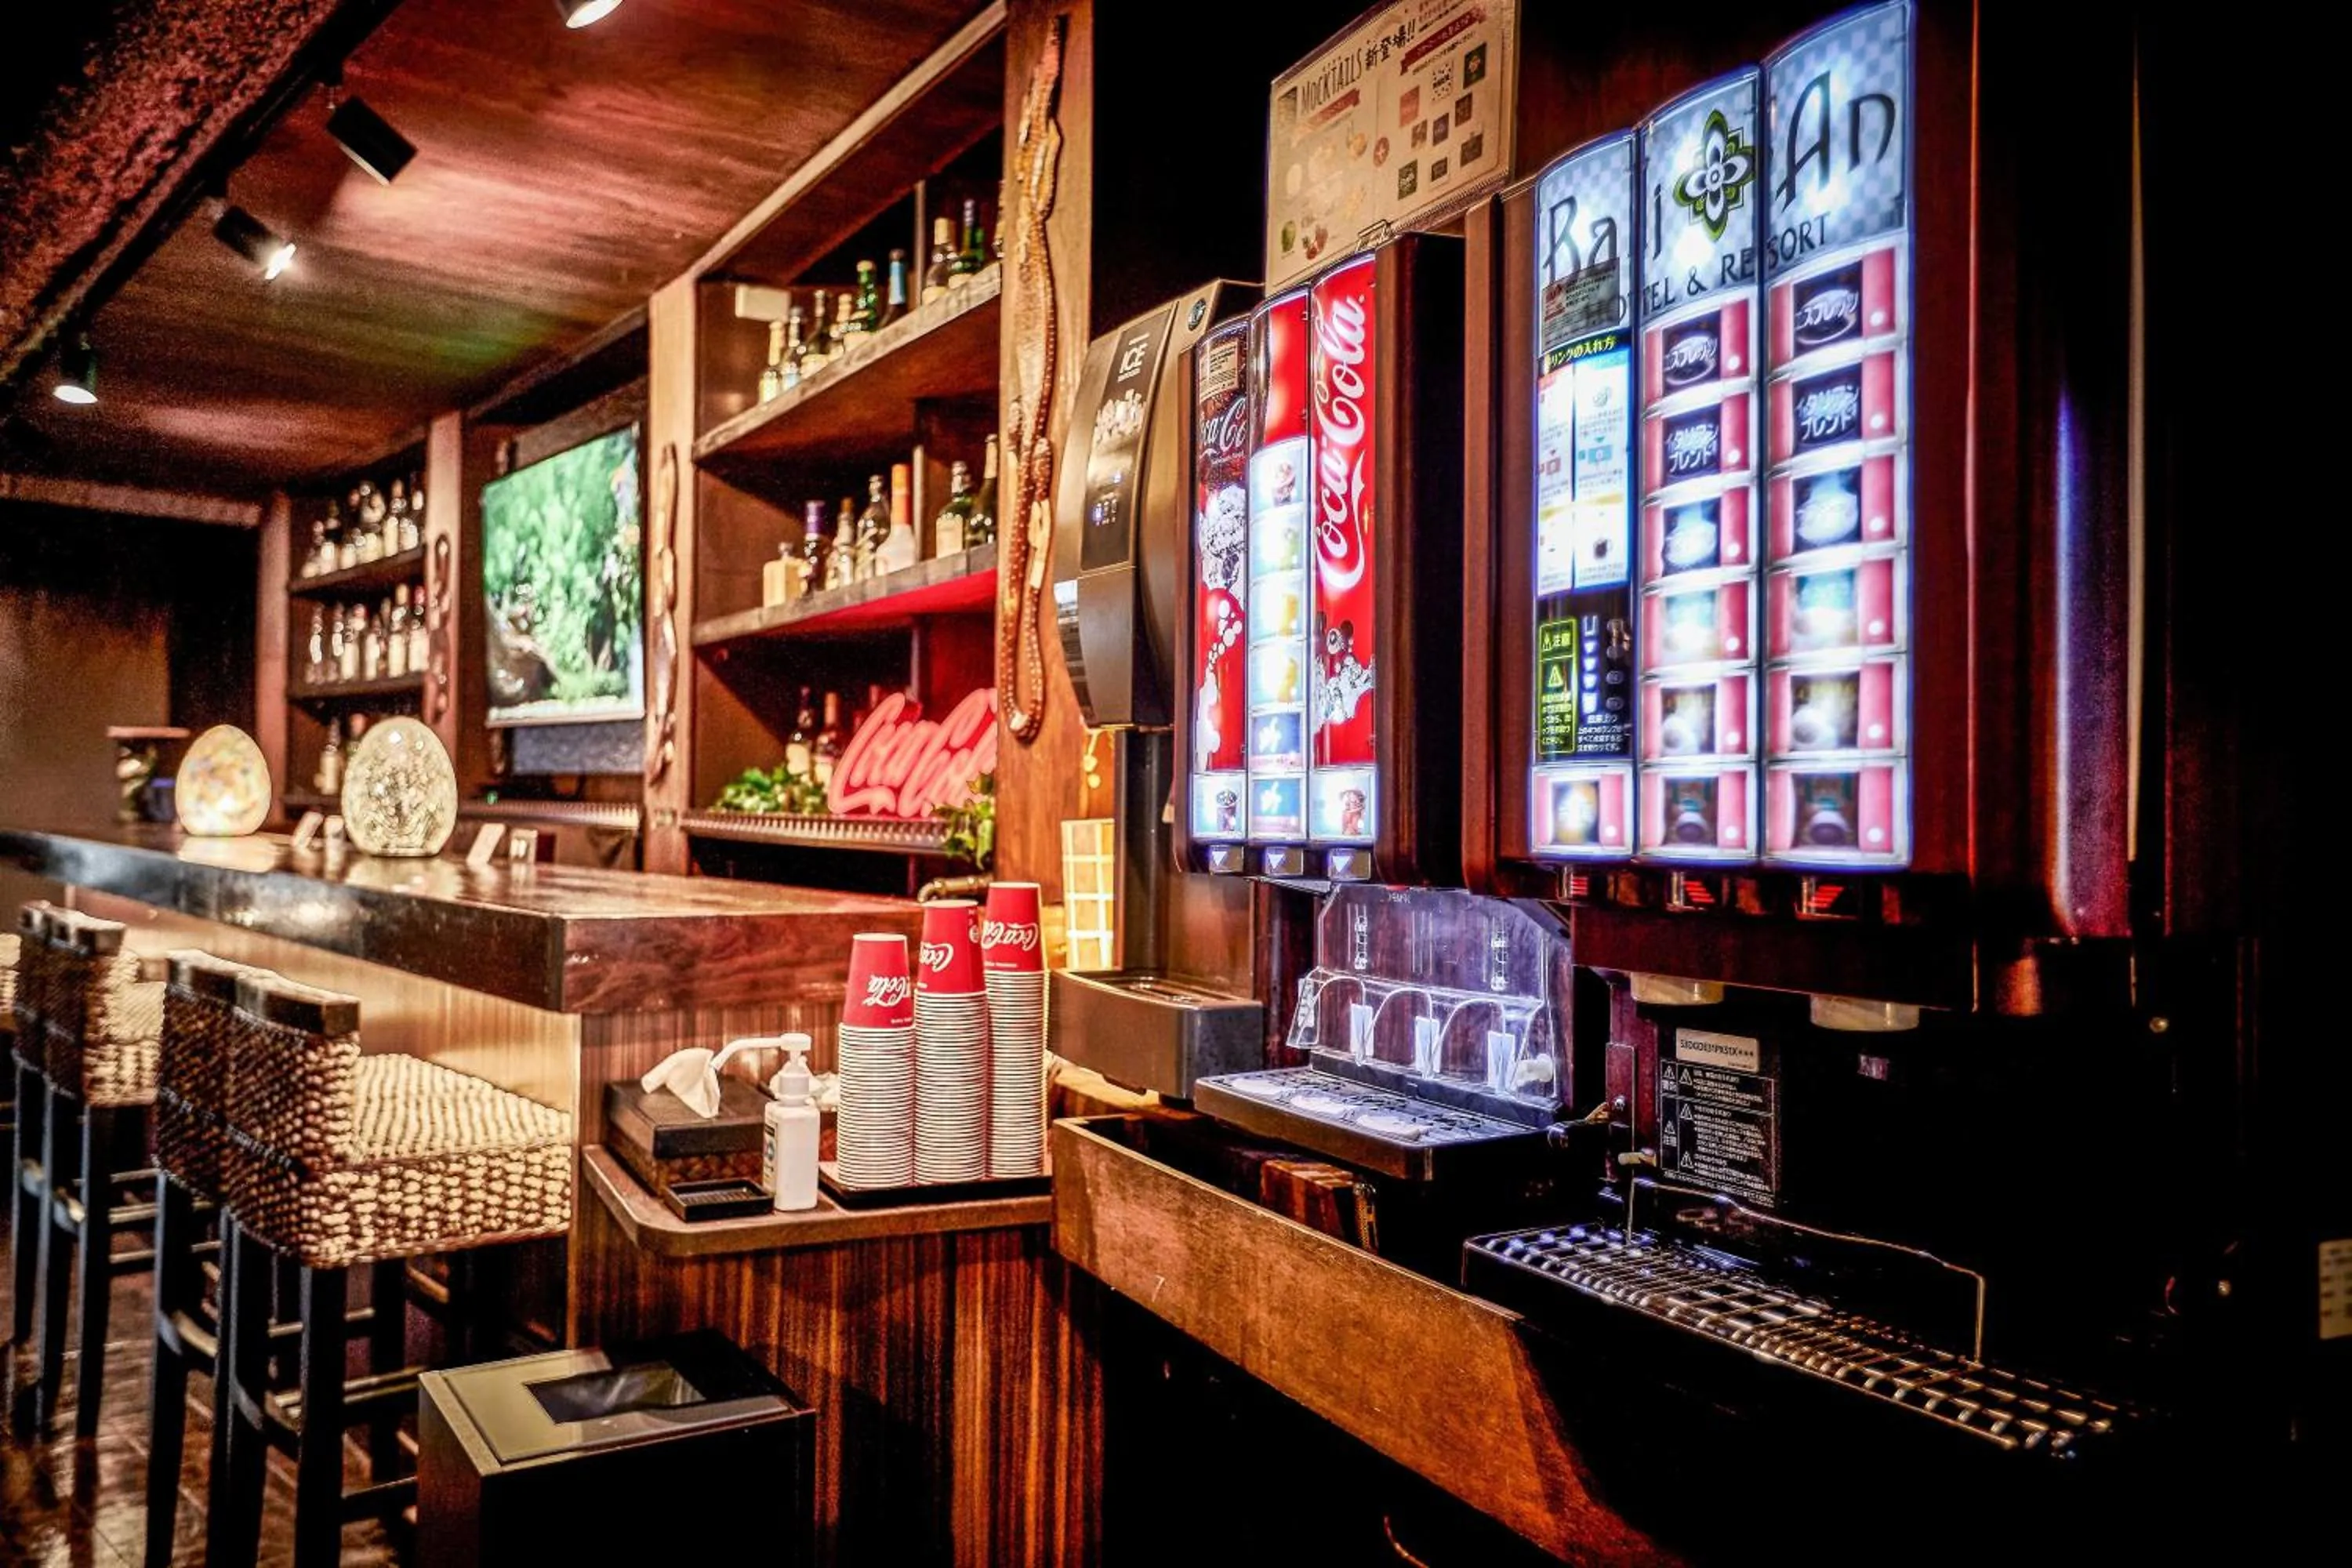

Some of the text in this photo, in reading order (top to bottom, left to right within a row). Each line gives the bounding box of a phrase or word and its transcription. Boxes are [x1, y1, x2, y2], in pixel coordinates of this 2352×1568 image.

[1301, 48, 1363, 115] MOCKTAILS
[1686, 266, 1708, 296] &
[1315, 295, 1366, 591] Coca-Cola
